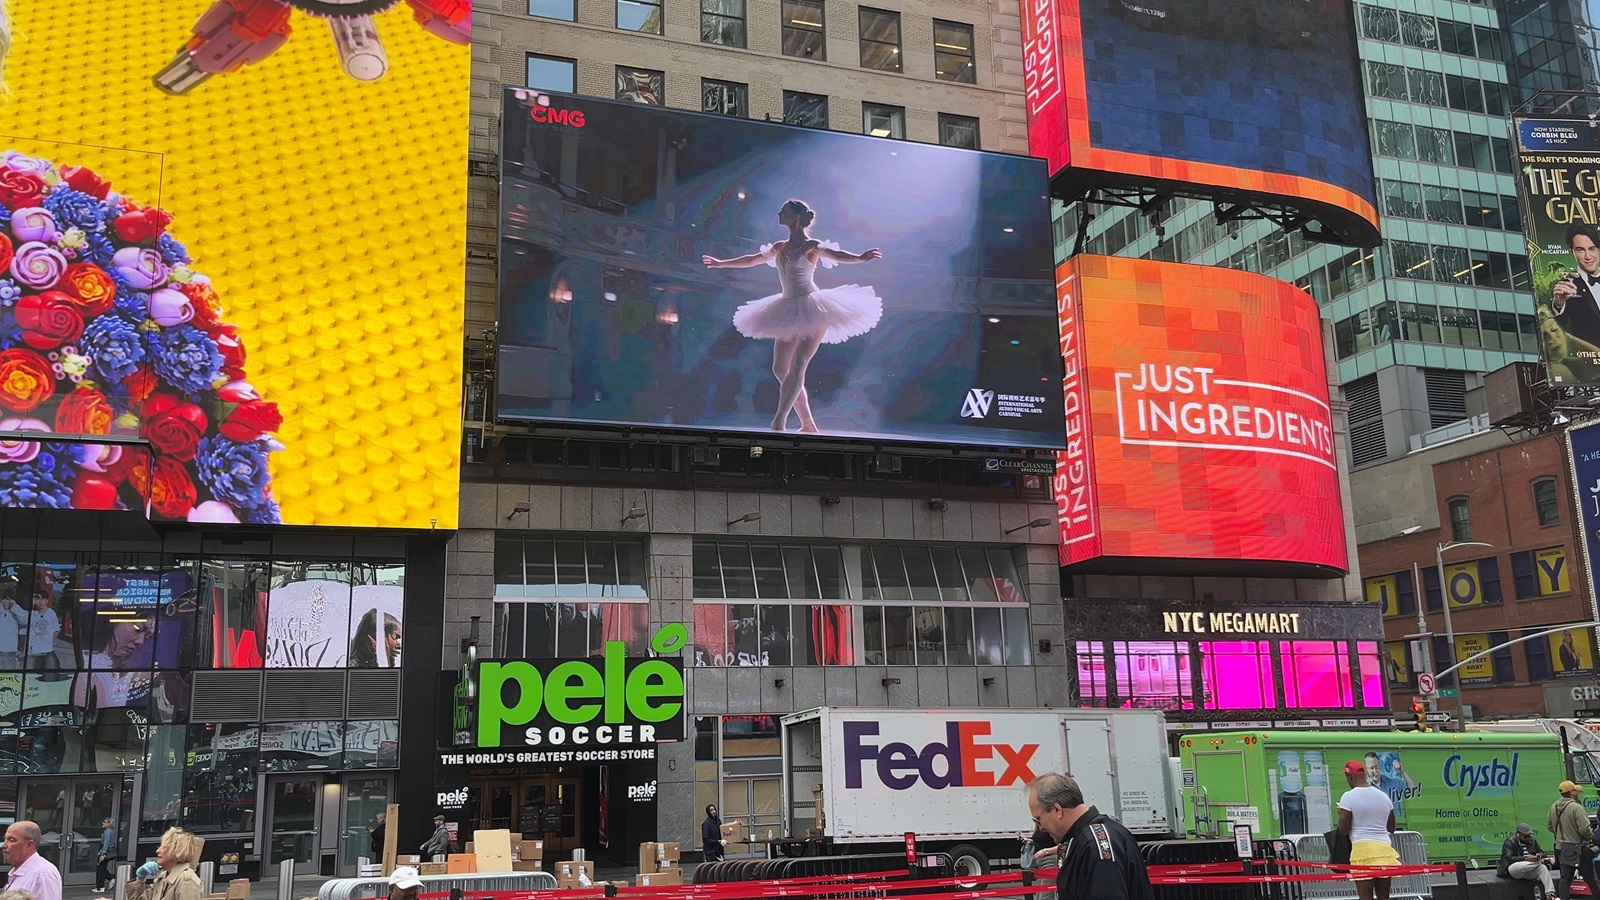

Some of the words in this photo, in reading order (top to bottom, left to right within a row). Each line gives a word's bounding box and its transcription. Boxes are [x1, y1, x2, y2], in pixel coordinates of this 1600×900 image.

[1024, 40, 1039, 99] JUST
[530, 106, 585, 128] CMG
[1523, 168, 1571, 195] THE
[1132, 364, 1214, 395] JUST
[1058, 293, 1088, 524] INGREDIENTS
[1138, 399, 1331, 455] INGREDIENTS
[1450, 572, 1476, 604] O
[1537, 556, 1565, 592] Y
[1163, 612, 1205, 633] NYC
[1209, 612, 1299, 633] MEGAMART
[478, 622, 688, 747] pelé
[525, 725, 656, 745] SOCCER
[441, 755, 463, 765] THE
[466, 753, 514, 764] WORLD'S
[516, 752, 574, 762] GREATEST
[576, 750, 618, 761] SOCCER
[620, 749, 654, 760] STORE
[843, 721, 1040, 790] FedEx
[628, 780, 657, 798] pelé
[1443, 752, 1519, 797] Crystal
[437, 786, 469, 805] pelé
[1436, 809, 1460, 818] Home
[1473, 808, 1498, 817] Office
